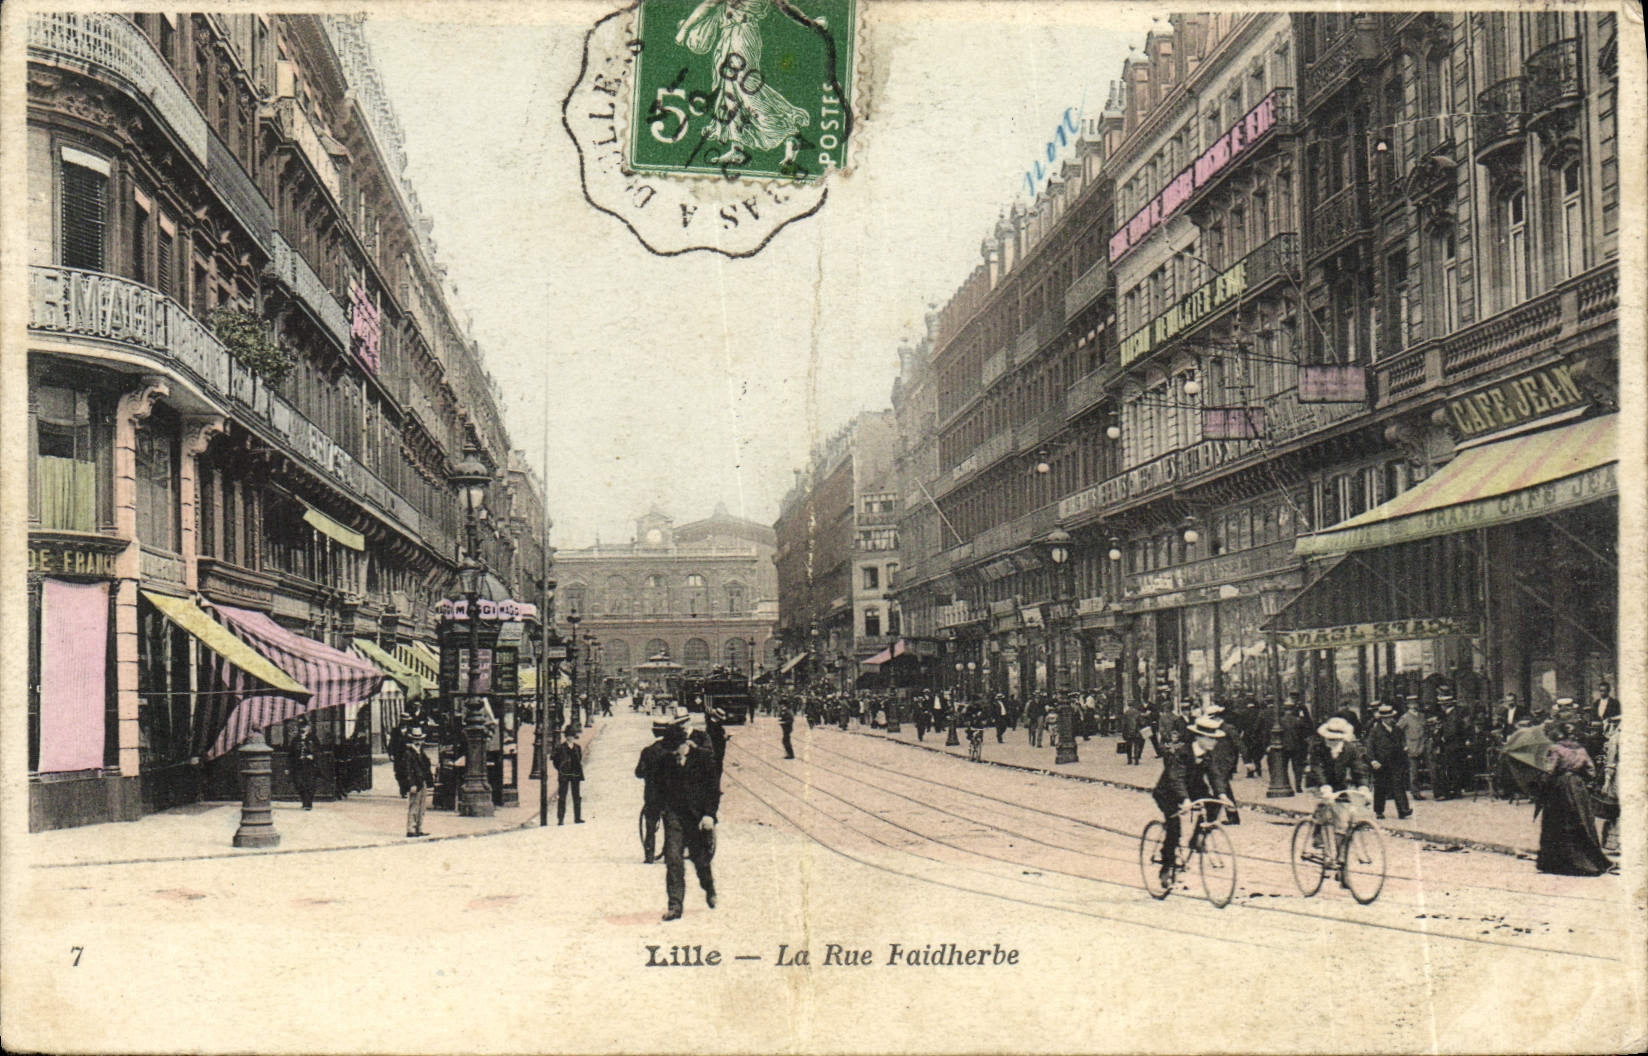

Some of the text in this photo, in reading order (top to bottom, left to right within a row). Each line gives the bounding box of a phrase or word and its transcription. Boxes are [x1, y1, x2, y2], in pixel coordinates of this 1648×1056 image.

[1451, 365, 1582, 434] CAFE JEAN
[1425, 502, 1485, 529] GRAND
[26, 548, 51, 572] DE
